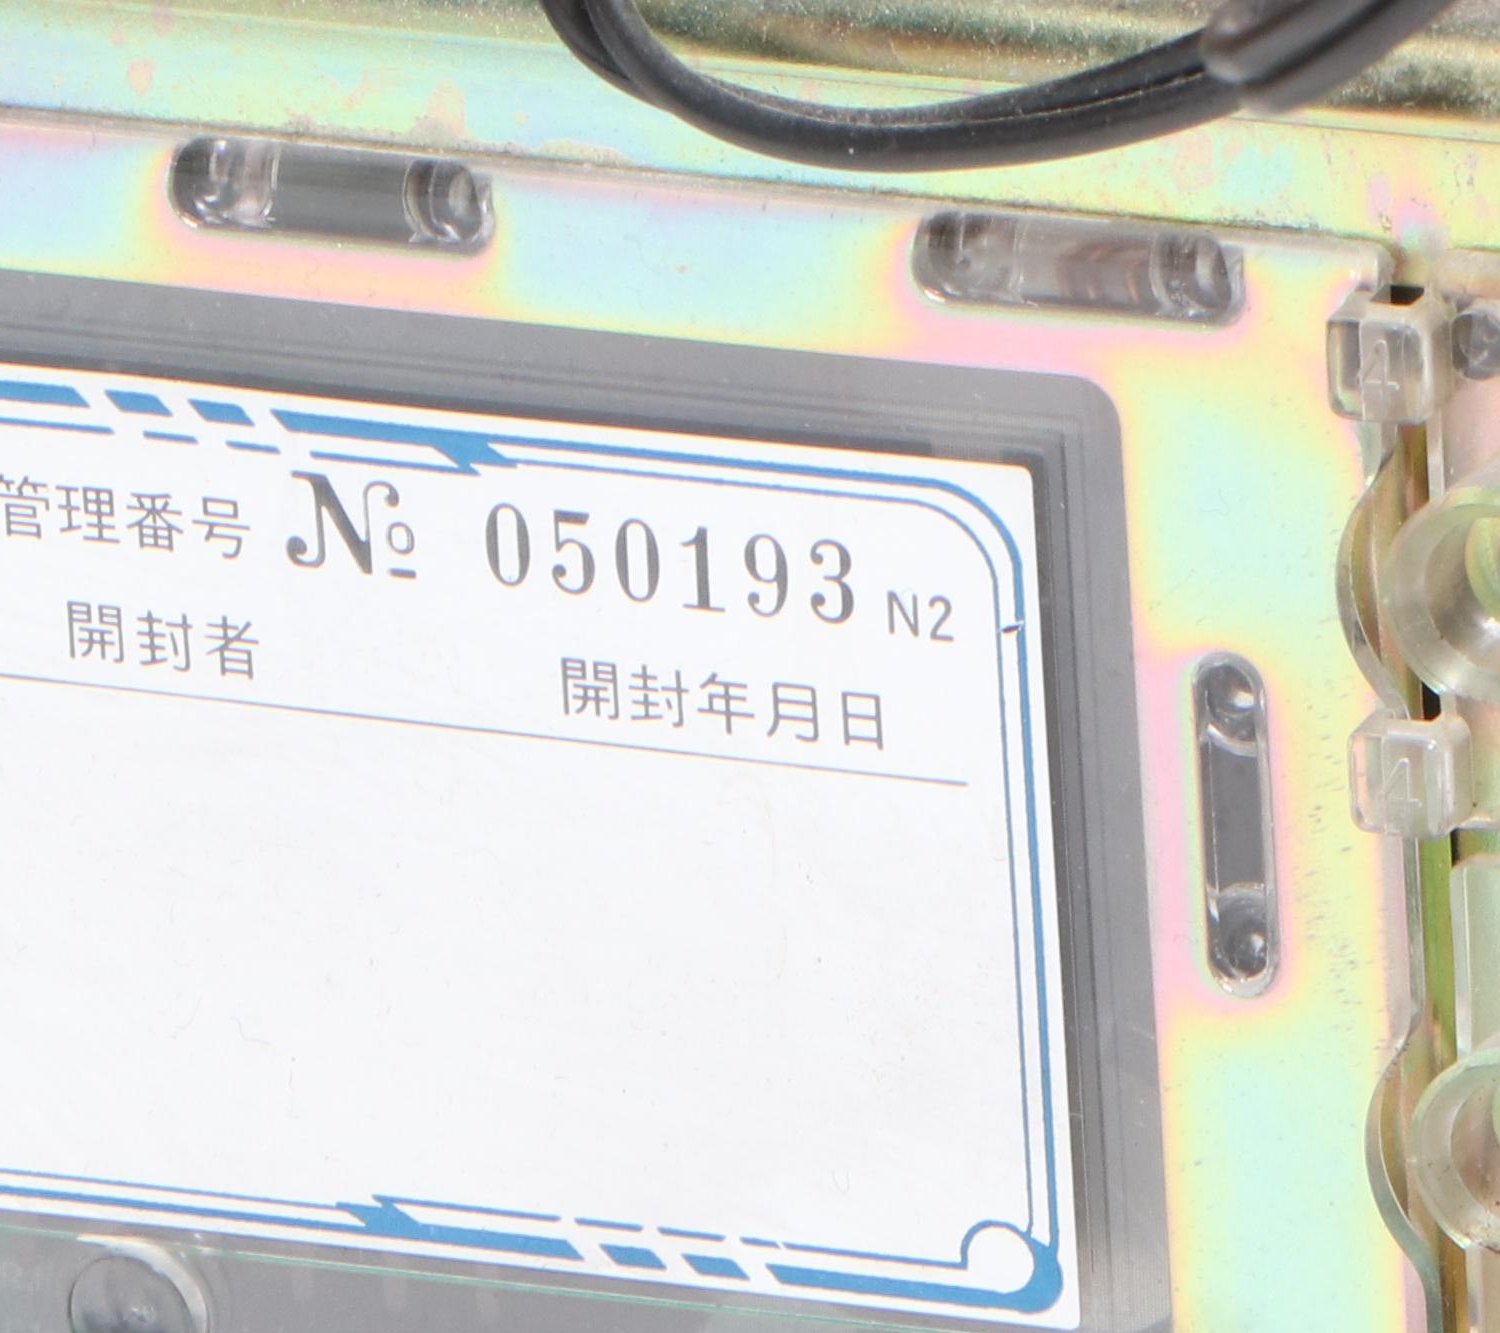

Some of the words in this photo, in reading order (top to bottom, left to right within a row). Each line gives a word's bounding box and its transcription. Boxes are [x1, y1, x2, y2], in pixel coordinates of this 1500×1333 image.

[485, 504, 857, 624] 050193
[887, 593, 956, 643] N2
[67, 600, 260, 681] 開封者
[559, 657, 888, 751] 開封年月日
